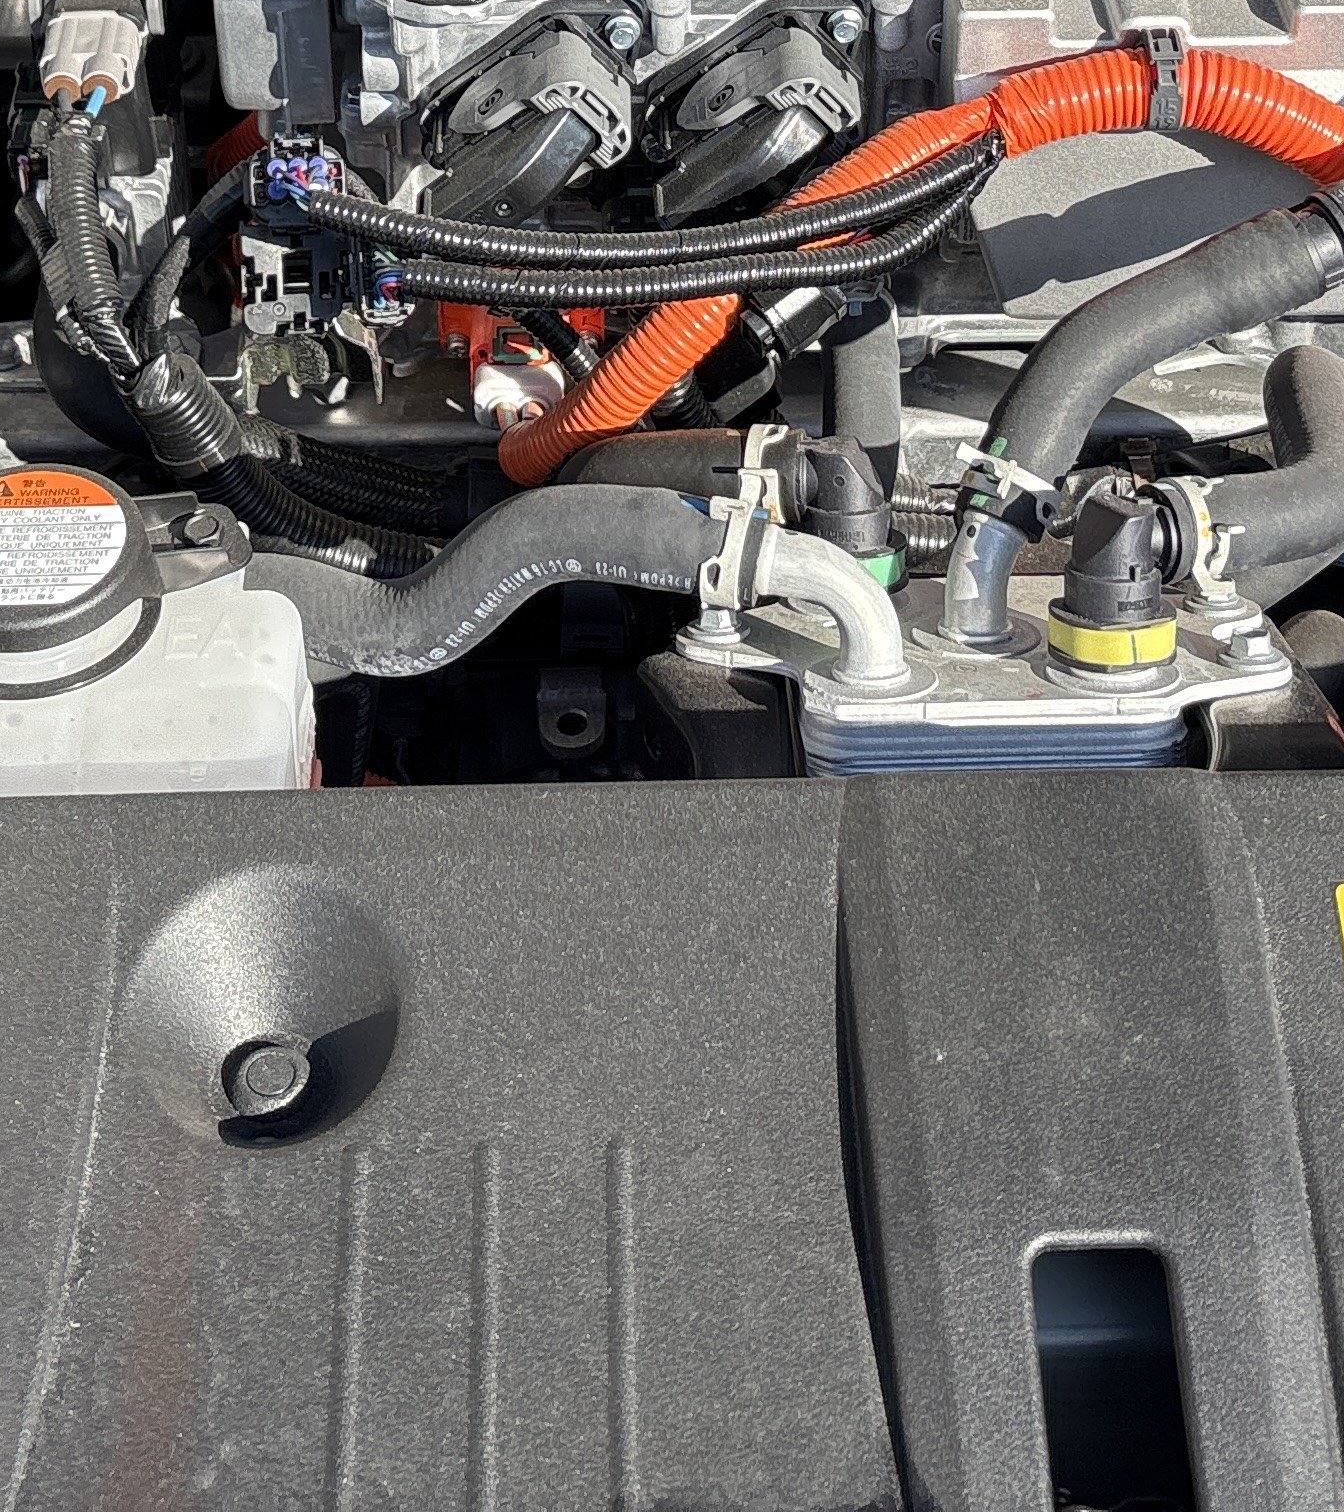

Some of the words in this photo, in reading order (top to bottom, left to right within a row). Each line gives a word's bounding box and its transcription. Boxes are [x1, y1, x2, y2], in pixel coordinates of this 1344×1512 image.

[20, 488, 80, 496] WARNING
[12, 524, 114, 534] REFROIDISSEMENT
[57, 532, 112, 540] TRACTION
[30, 540, 103, 549] UNIQUEMENT
[7, 550, 109, 559] REFROIDISSEMENT
[23, 559, 38, 567] DE
[45, 558, 100, 566] TRACTION
[15, 566, 88, 575] UNIQUEMENT
